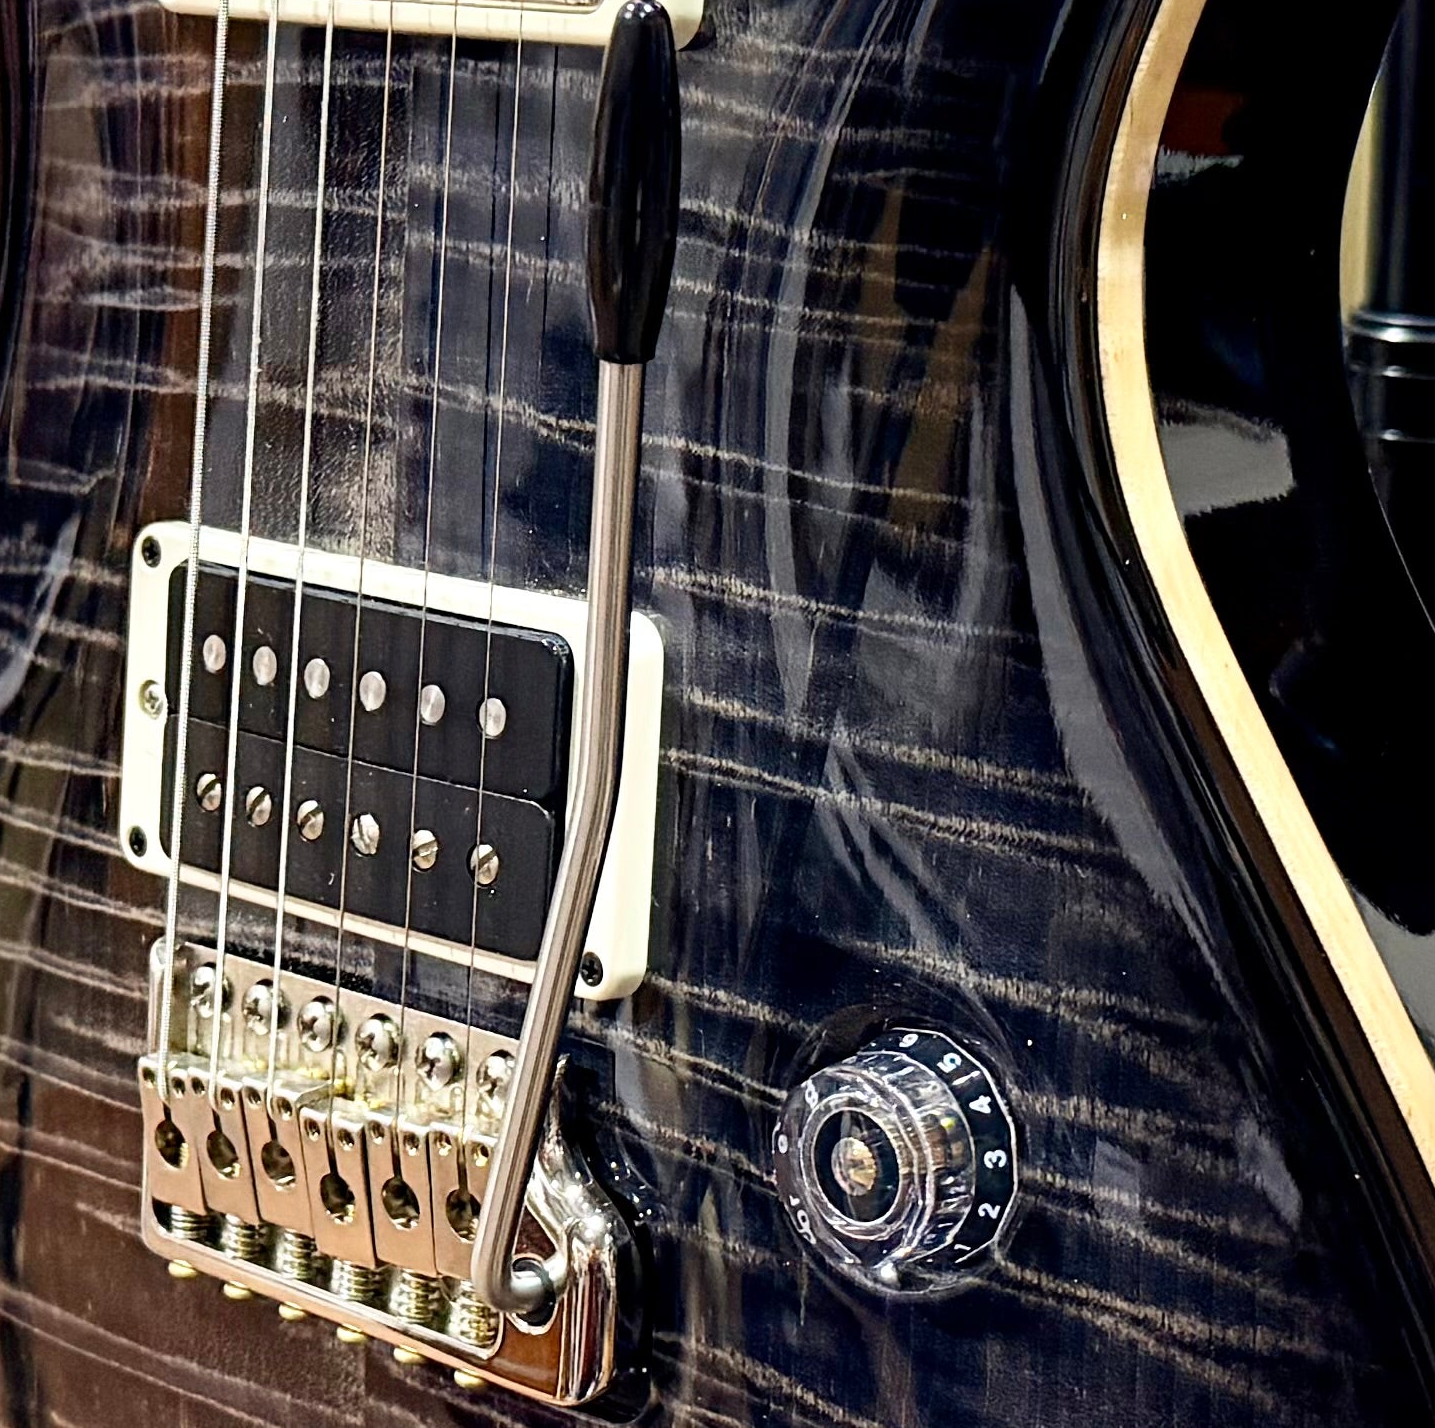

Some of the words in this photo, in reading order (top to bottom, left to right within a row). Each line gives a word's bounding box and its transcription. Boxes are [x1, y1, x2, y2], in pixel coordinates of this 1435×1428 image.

[937, 1052, 962, 1072] 5
[969, 1094, 992, 1113] 4
[983, 1148, 1007, 1169] 3
[977, 1202, 1001, 1220] 2
